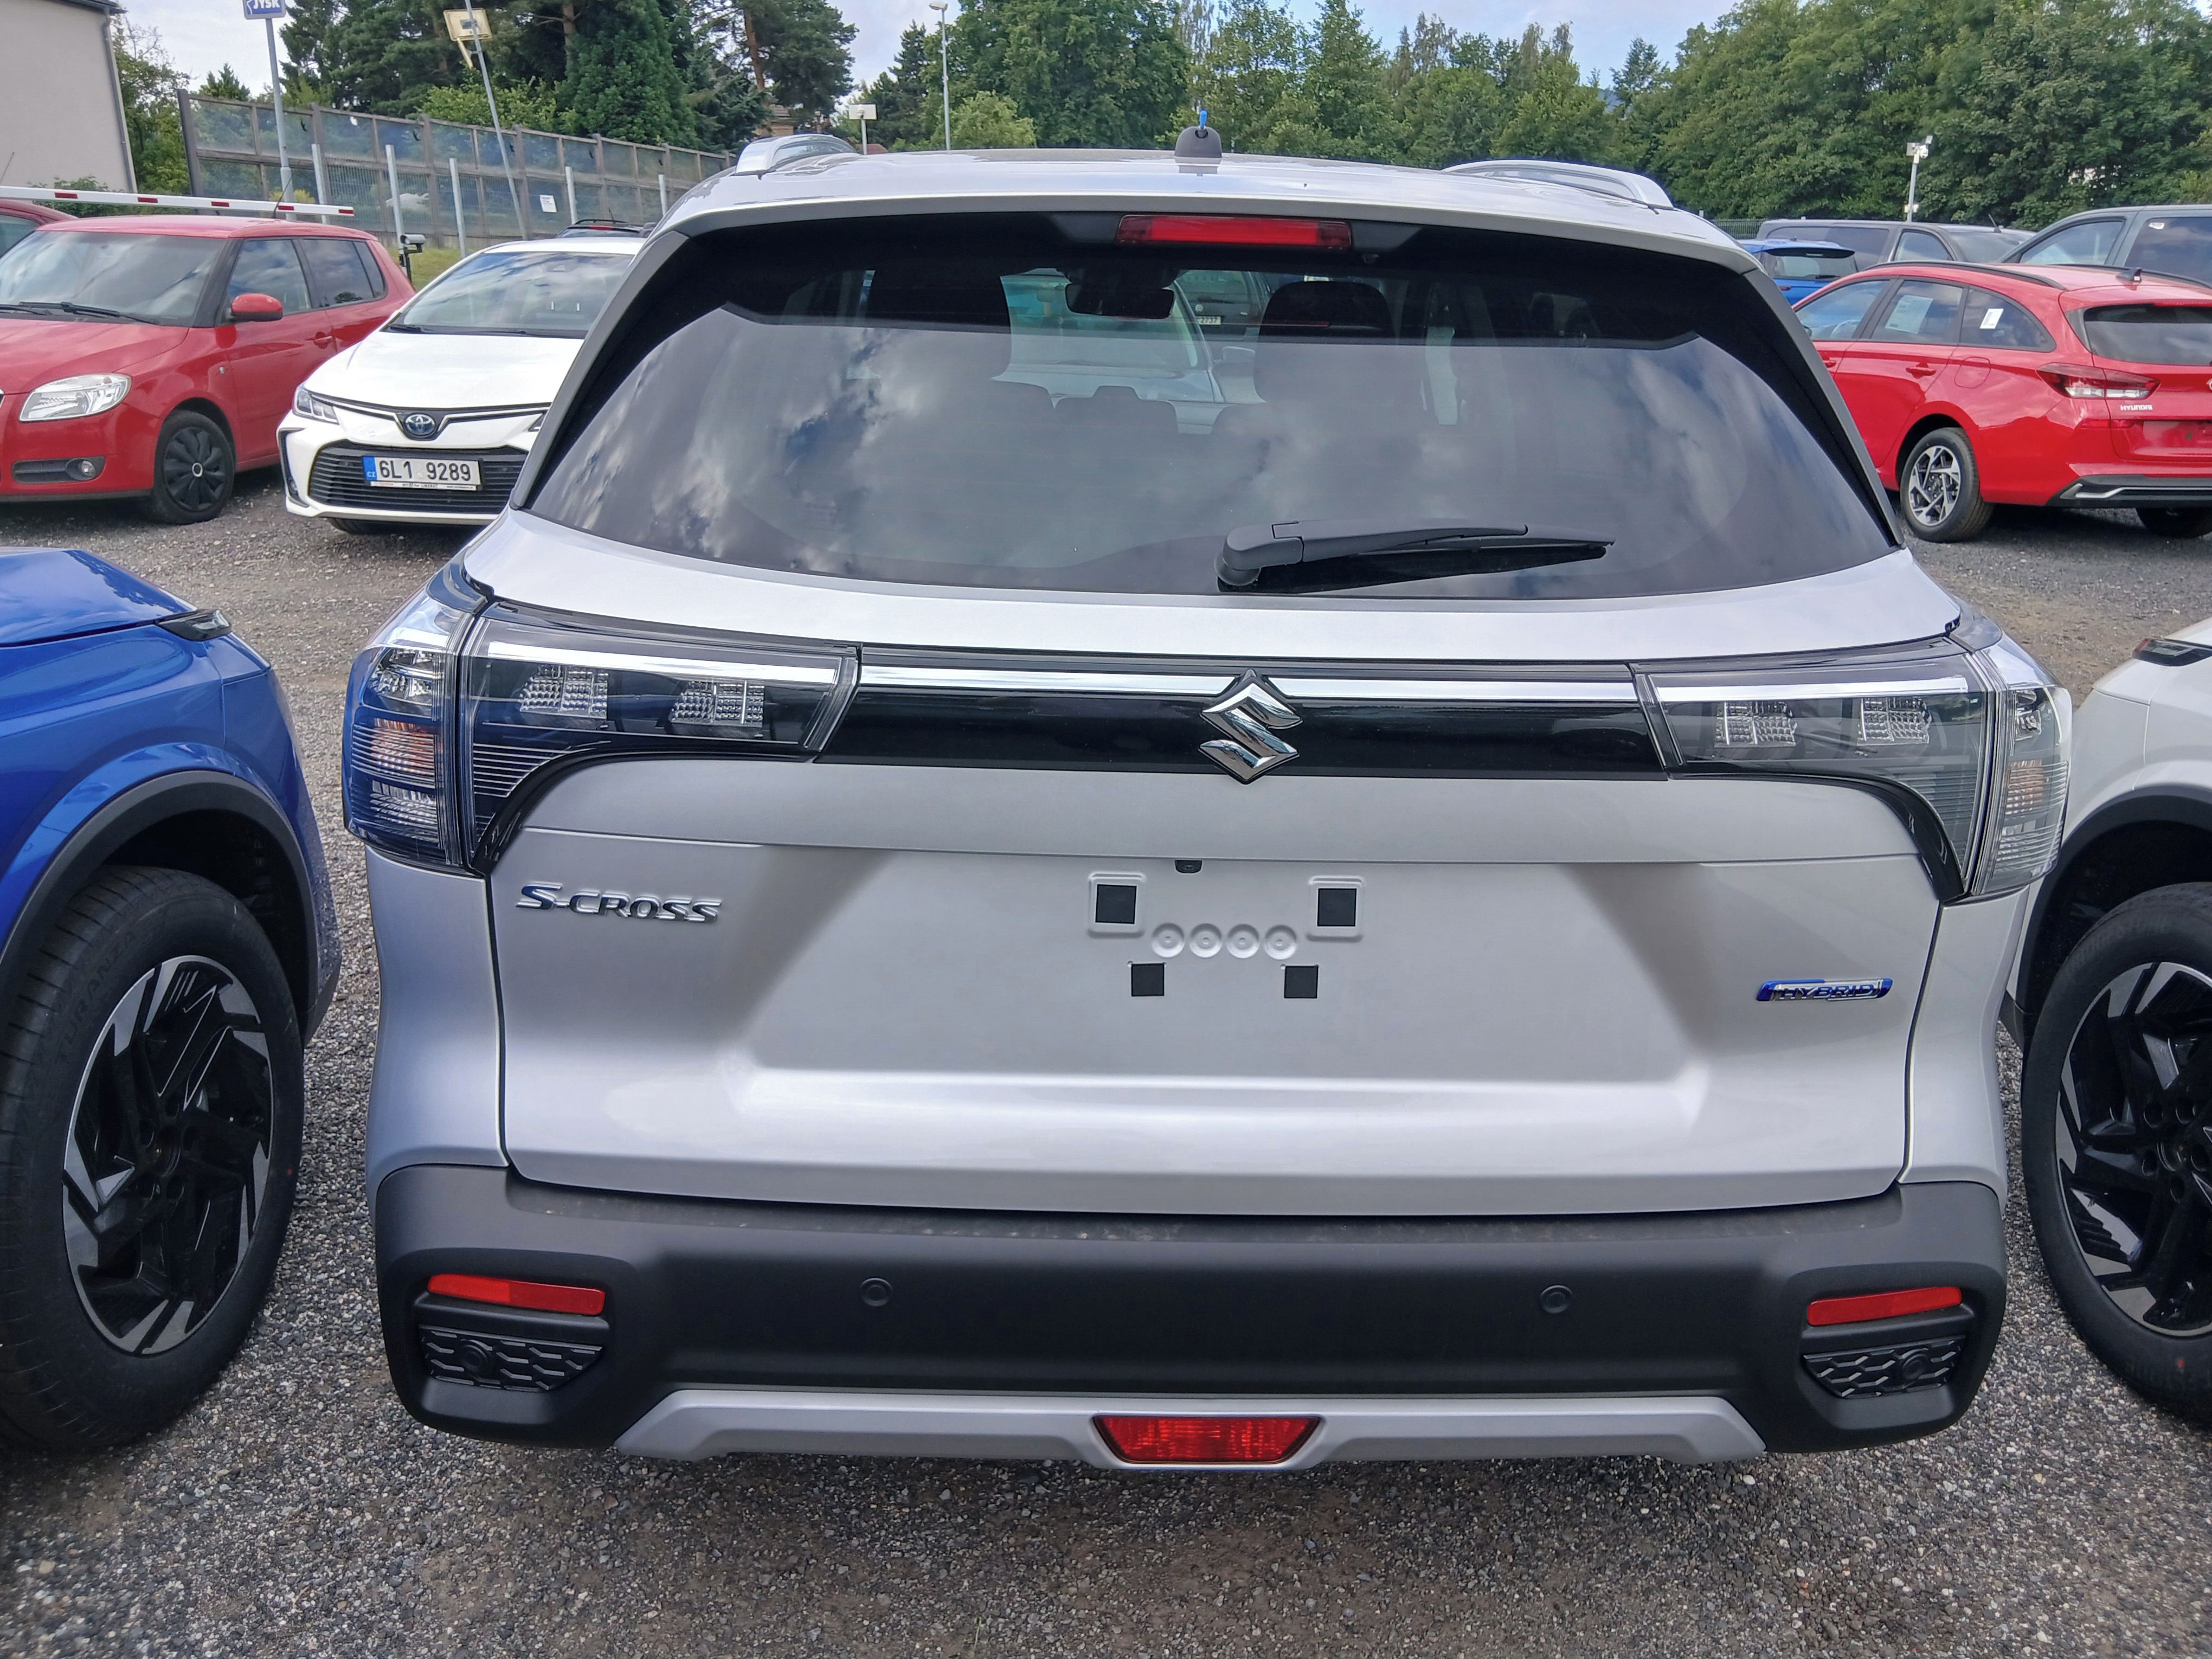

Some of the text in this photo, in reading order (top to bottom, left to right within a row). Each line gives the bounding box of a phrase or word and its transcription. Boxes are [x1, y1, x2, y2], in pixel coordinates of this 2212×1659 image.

[253, 0, 280, 9] JYSK
[380, 460, 471, 481] 6L1 9289
[516, 881, 722, 923] S-CROSS
[1778, 983, 1875, 1000] HYBRID
